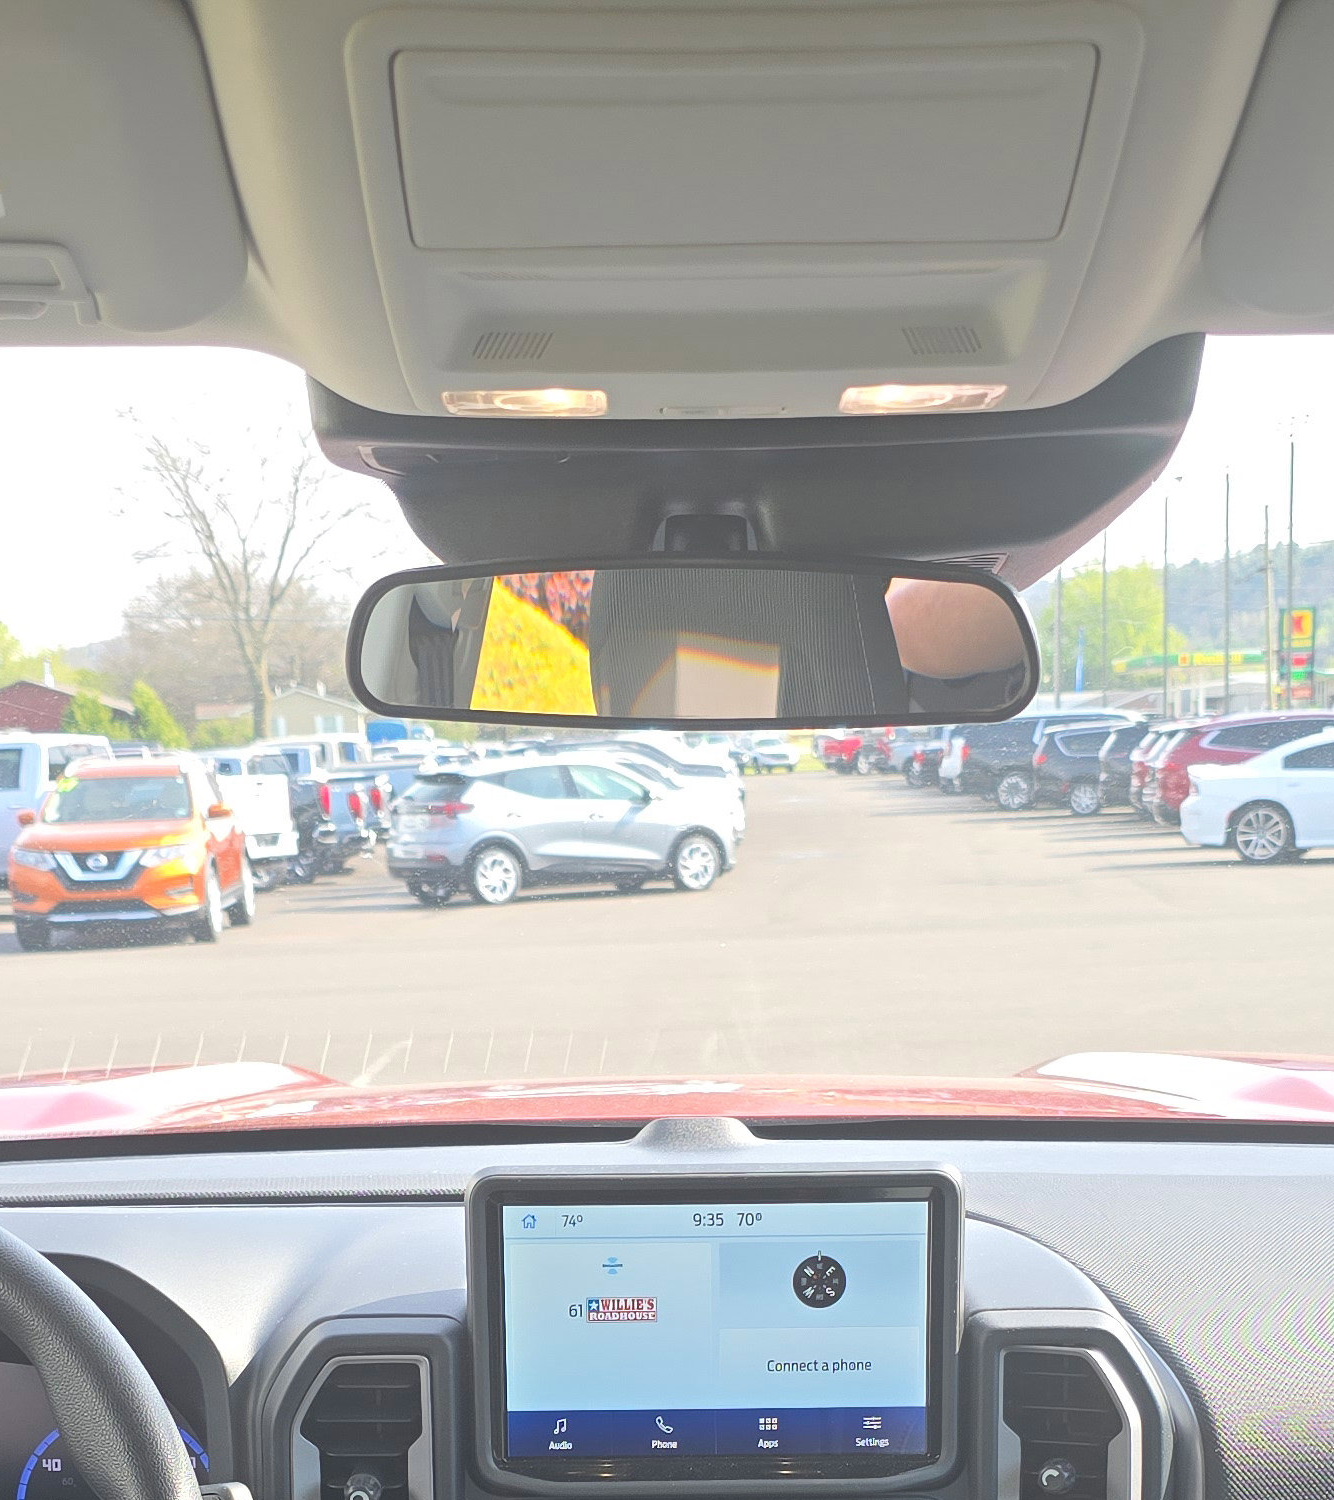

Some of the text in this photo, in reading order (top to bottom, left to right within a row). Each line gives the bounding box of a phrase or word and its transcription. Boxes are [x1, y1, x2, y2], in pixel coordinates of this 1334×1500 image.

[692, 1213, 725, 1229] 9:35
[803, 1265, 815, 1278] N
[825, 1265, 836, 1277] E
[803, 1286, 815, 1299] W
[825, 1287, 836, 1297] S
[569, 1303, 584, 1319] 61
[600, 1298, 655, 1311] WILLIE'S
[589, 1311, 656, 1321] ROADHOUSE
[766, 1357, 872, 1376] Connect a phone
[548, 1439, 573, 1451] Audio
[651, 1438, 678, 1450] Phone
[757, 1437, 779, 1451] Apps
[855, 1436, 890, 1449] Settings
[42, 1458, 62, 1472] 40
